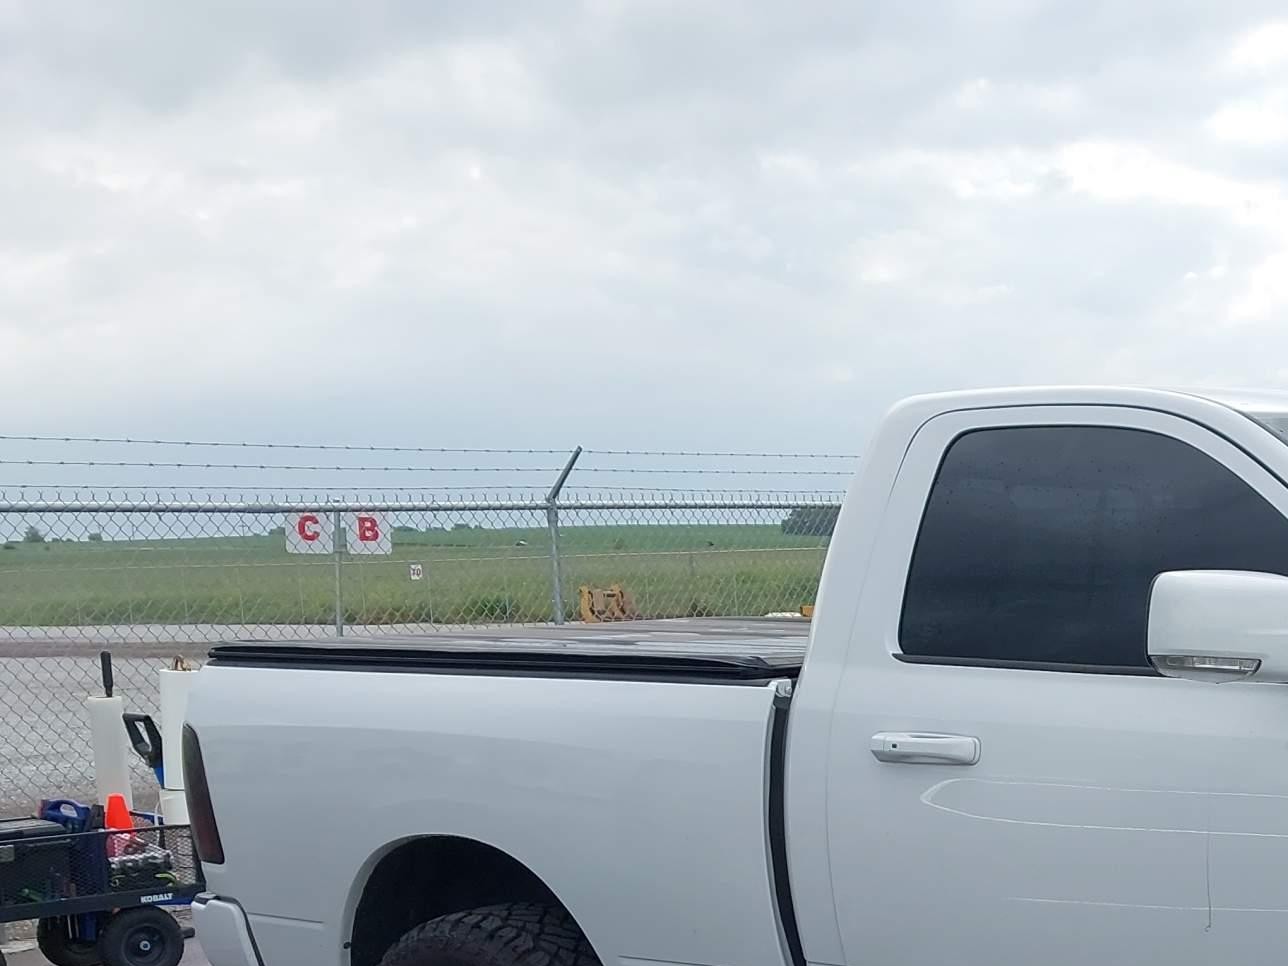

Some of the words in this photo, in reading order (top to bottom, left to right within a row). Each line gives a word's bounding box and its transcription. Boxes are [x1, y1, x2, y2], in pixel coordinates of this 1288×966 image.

[297, 514, 321, 541] C
[356, 516, 380, 542] B
[140, 893, 173, 904] KOBALT
